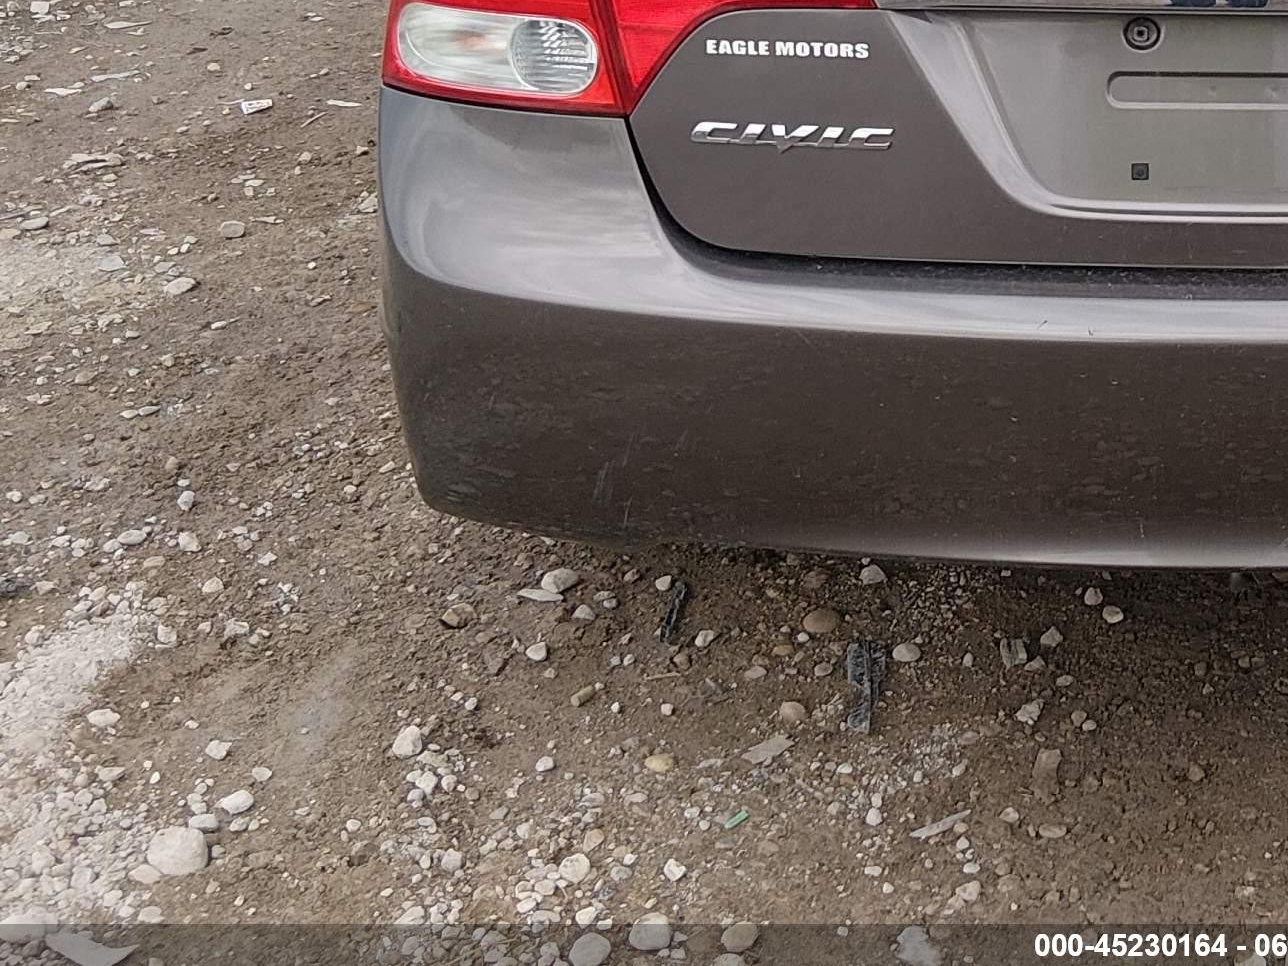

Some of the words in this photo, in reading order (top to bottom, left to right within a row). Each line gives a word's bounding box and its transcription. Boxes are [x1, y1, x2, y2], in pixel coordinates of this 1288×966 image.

[705, 39, 770, 56] EAGLE
[775, 41, 870, 59] MOTORS
[690, 121, 895, 154] CIVIC
